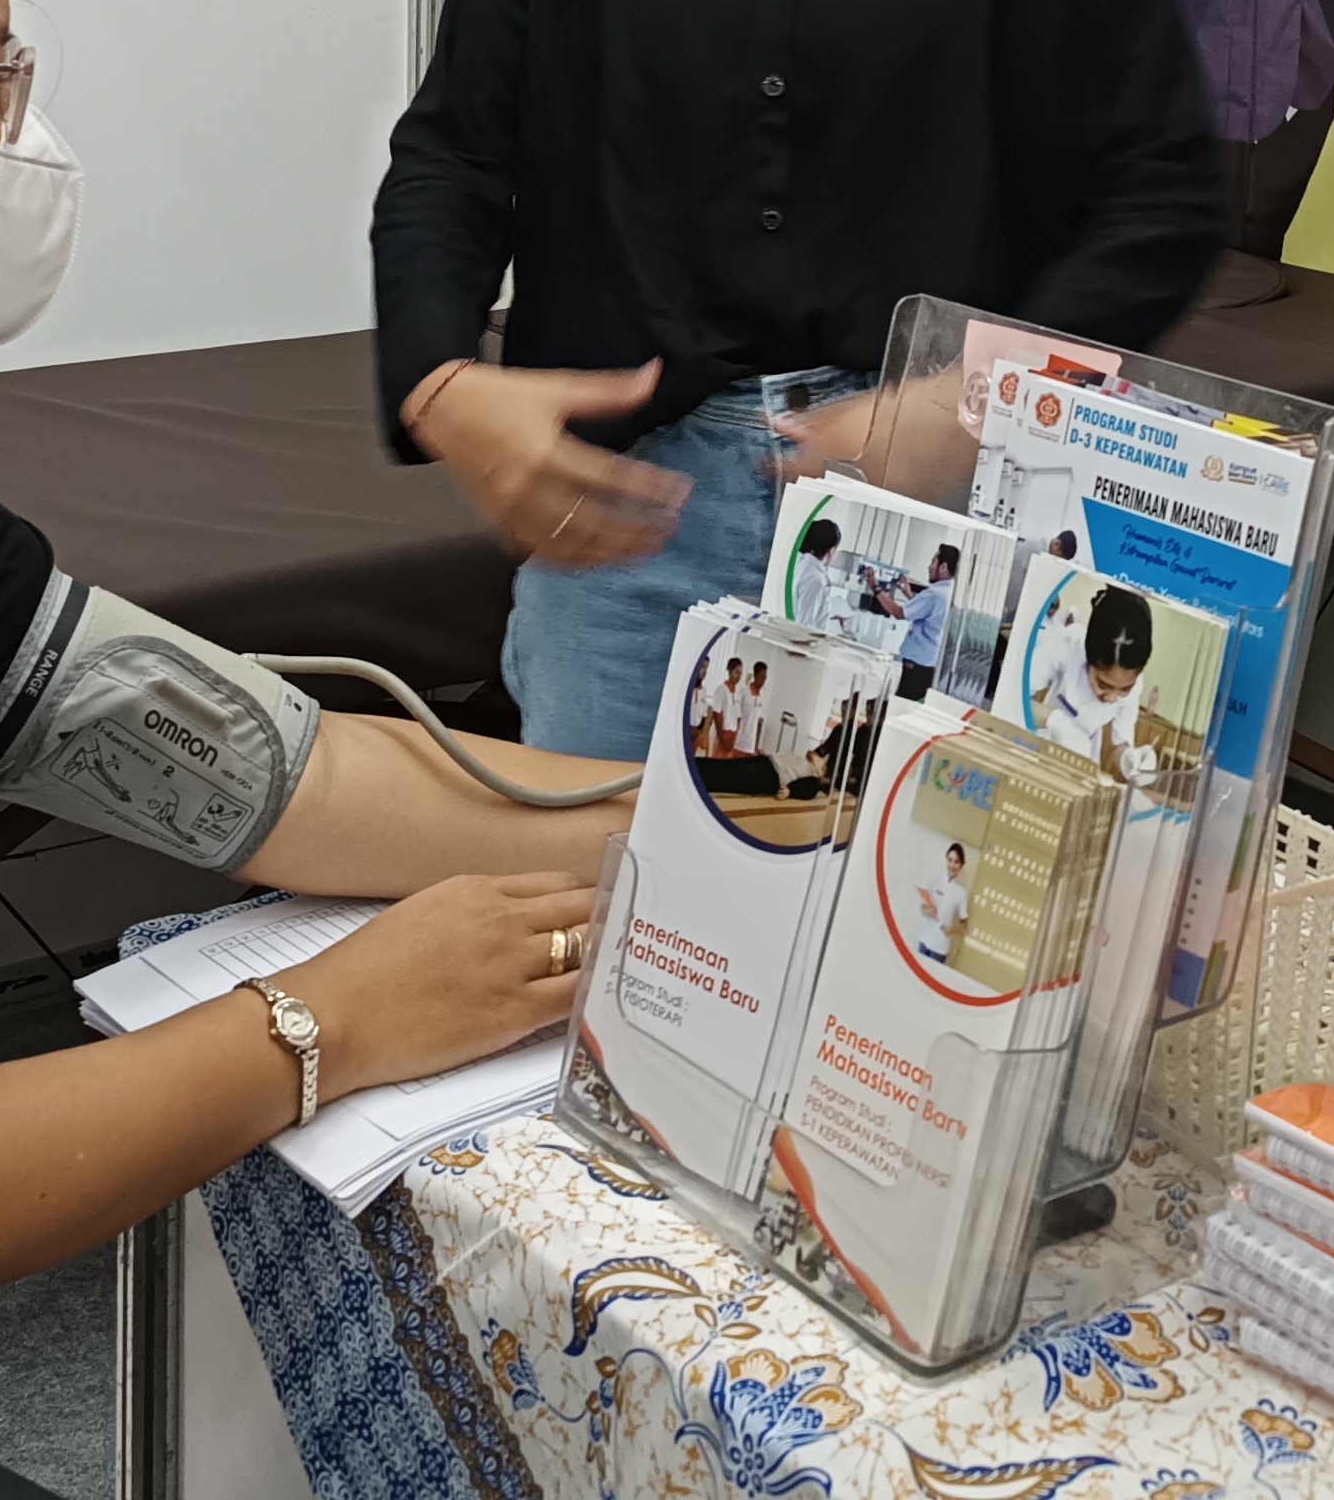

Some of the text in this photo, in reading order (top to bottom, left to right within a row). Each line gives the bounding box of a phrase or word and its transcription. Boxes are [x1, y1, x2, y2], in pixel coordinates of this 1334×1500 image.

[1074, 405, 1137, 437] PROGRAM
[1139, 424, 1178, 450] STUDI
[1070, 428, 1091, 449] D-3
[1094, 435, 1188, 479] KEPERAWATAN
[1093, 475, 1279, 557] PENERIMAAN MAHASISWA BARU
[26, 649, 58, 698] RANGE
[144, 710, 218, 768] OMRON
[719, 978, 761, 1014] Baru
[824, 1013, 933, 1093] Penerimaan
